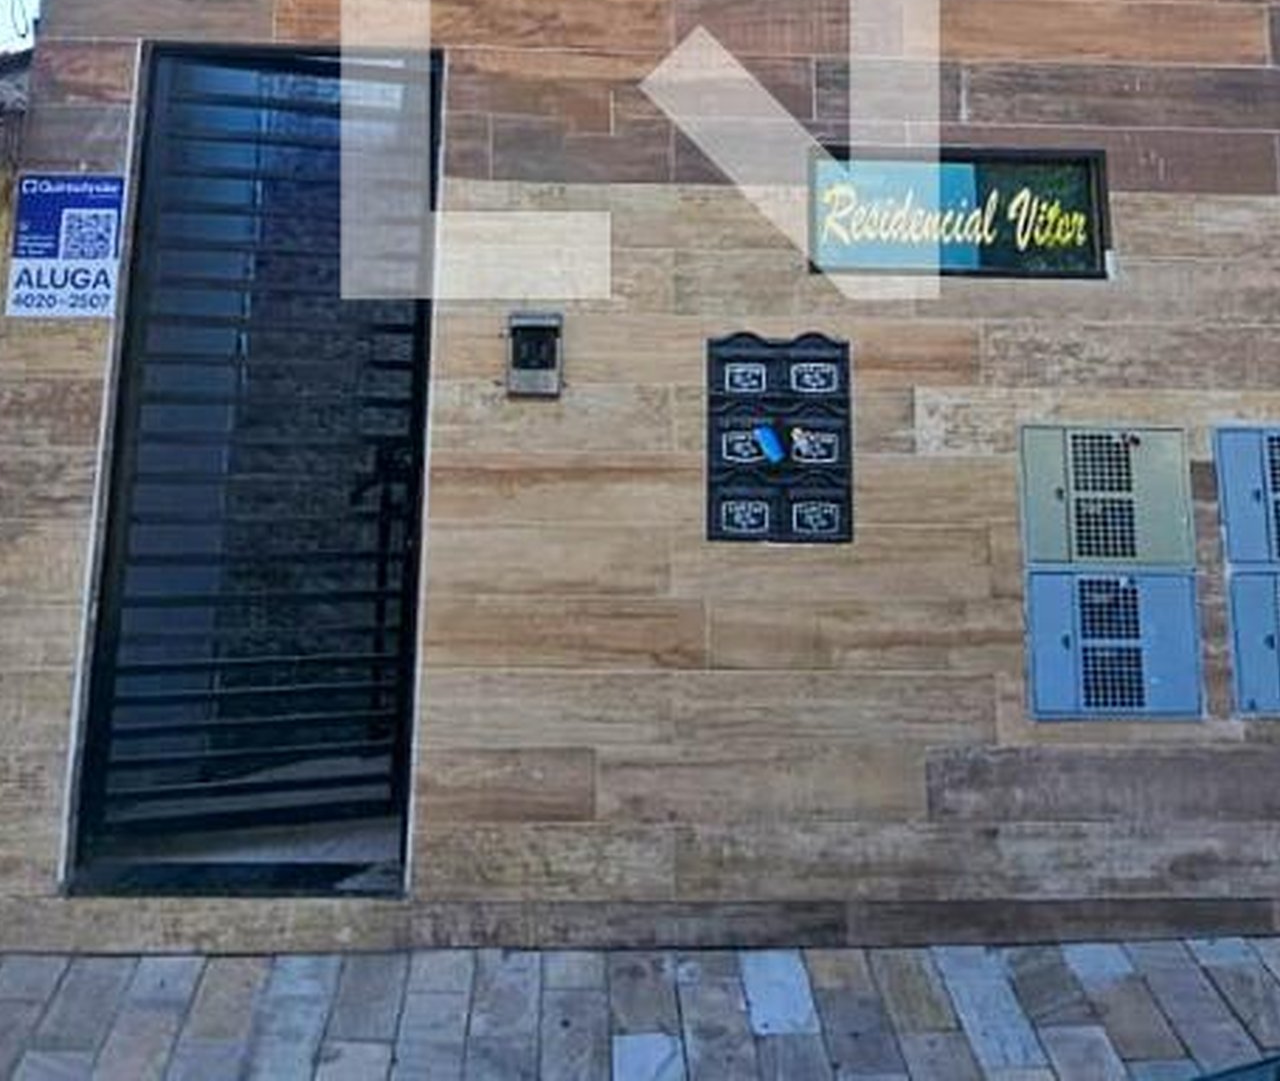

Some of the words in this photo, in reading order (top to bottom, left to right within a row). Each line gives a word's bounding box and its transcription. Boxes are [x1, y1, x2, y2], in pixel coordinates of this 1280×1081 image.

[824, 181, 999, 246] Residencial
[1008, 186, 1087, 251] Vitor
[15, 268, 111, 290] ALUGA
[12, 293, 111, 310] 4020-2507
